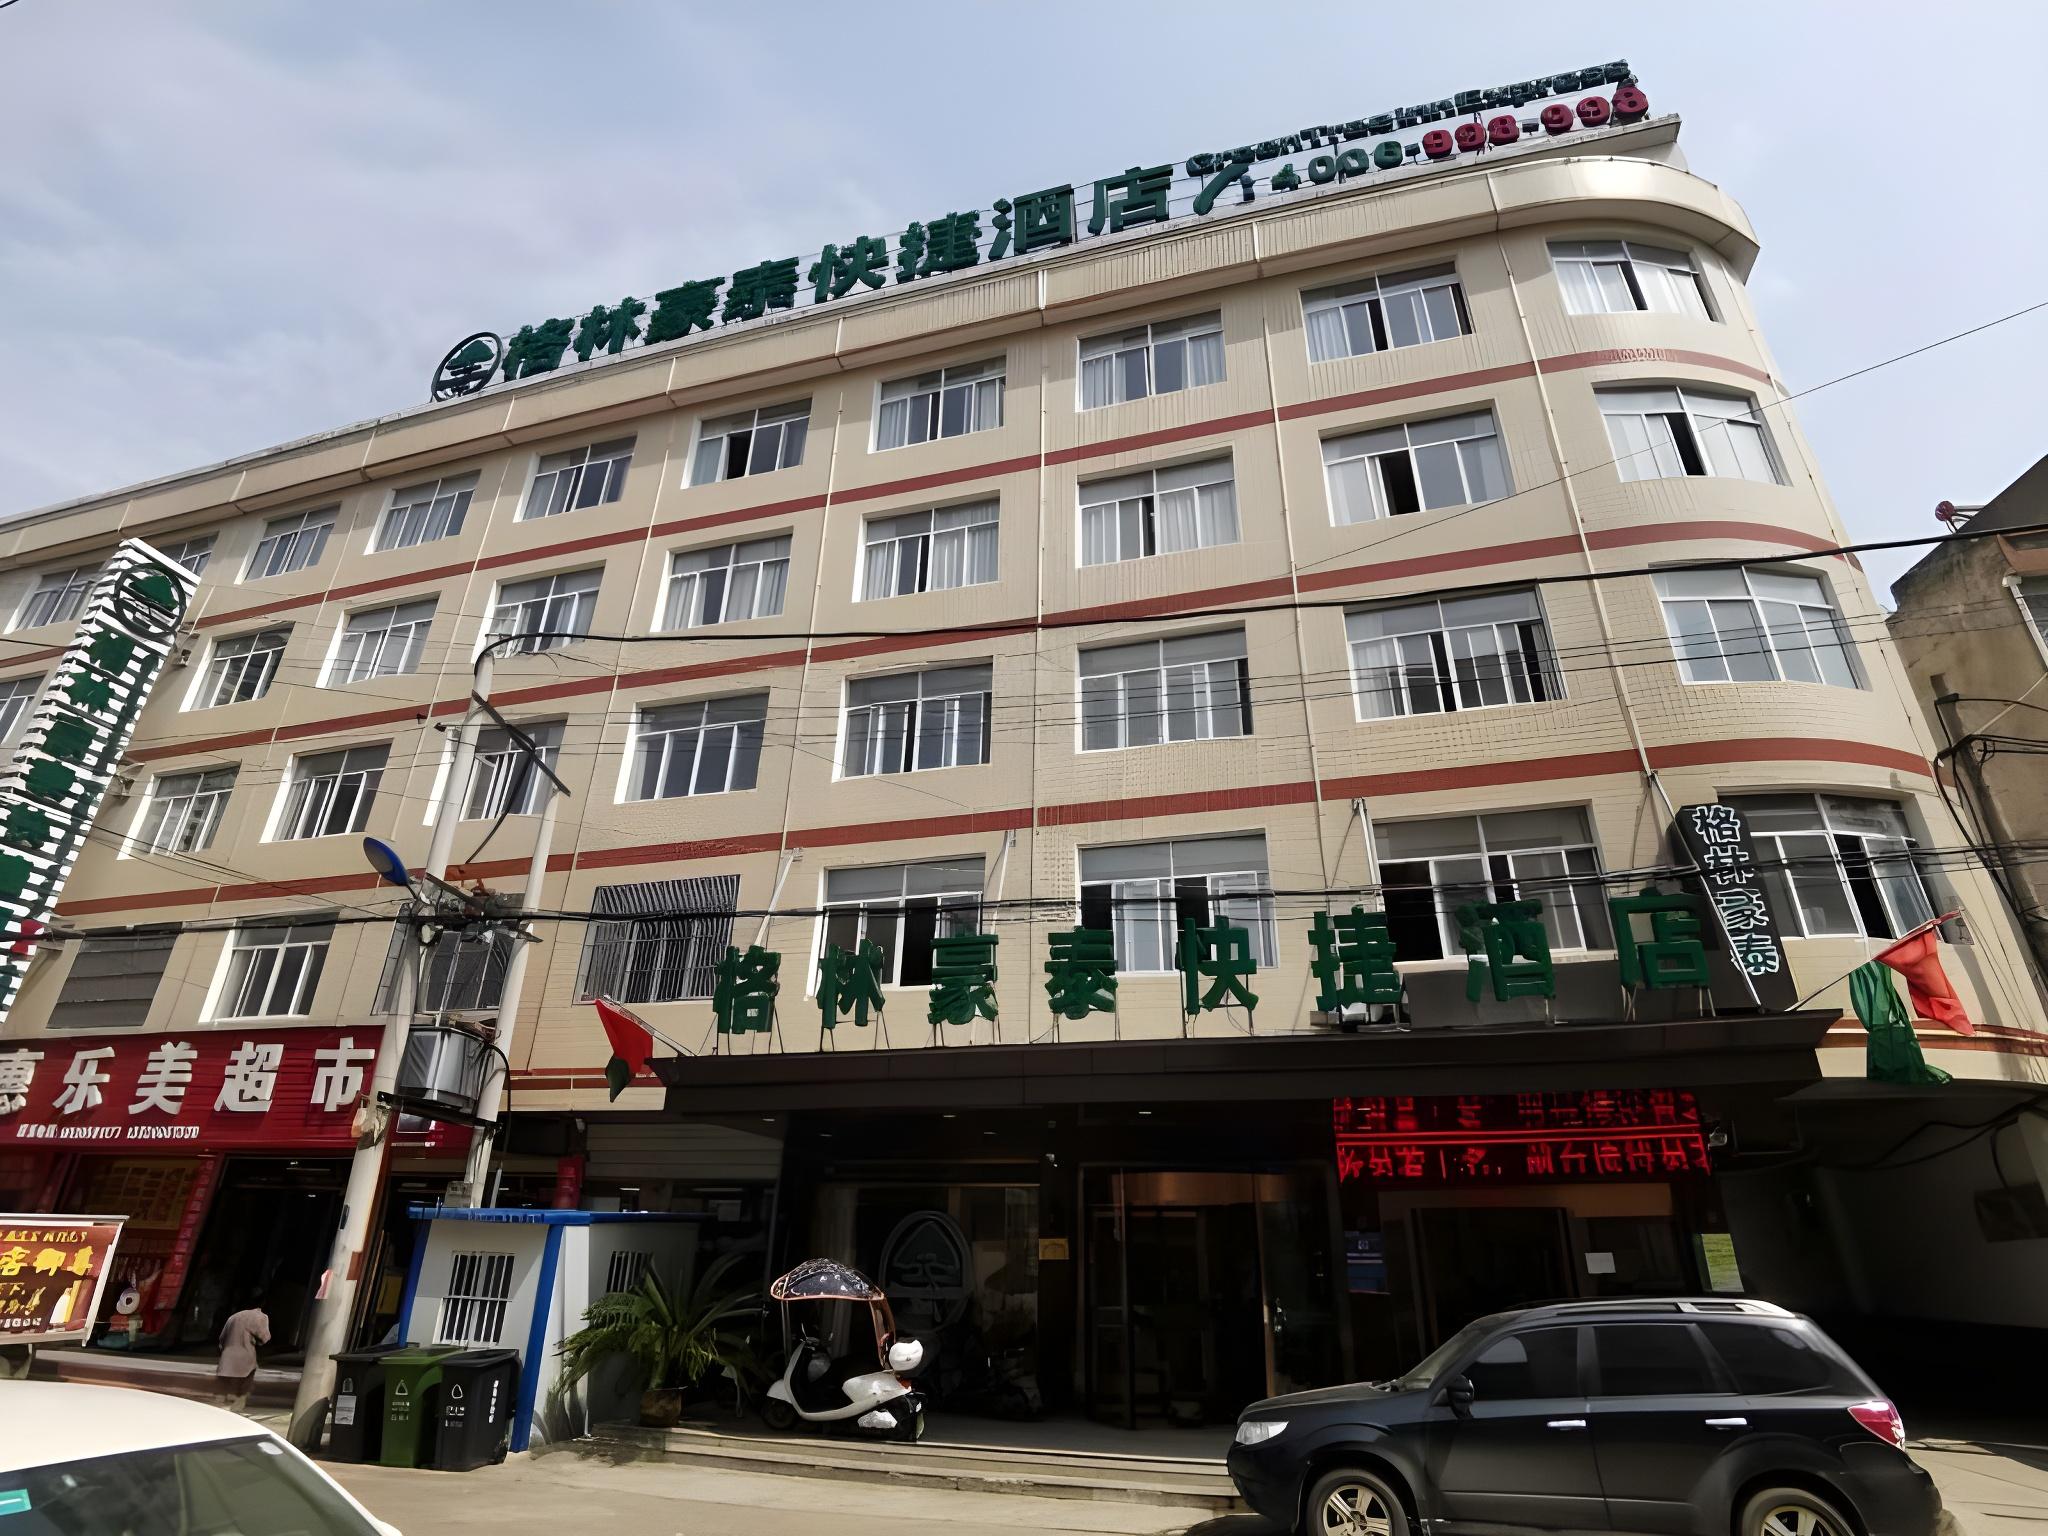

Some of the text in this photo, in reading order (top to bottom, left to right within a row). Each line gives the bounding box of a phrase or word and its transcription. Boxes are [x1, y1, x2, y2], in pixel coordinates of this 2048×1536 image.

[713, 886, 1710, 1035] 格林豪泰快捷酒店
[1692, 805, 1781, 977] 格林豪泰
[0, 1036, 376, 1116] 惠乐美超市
